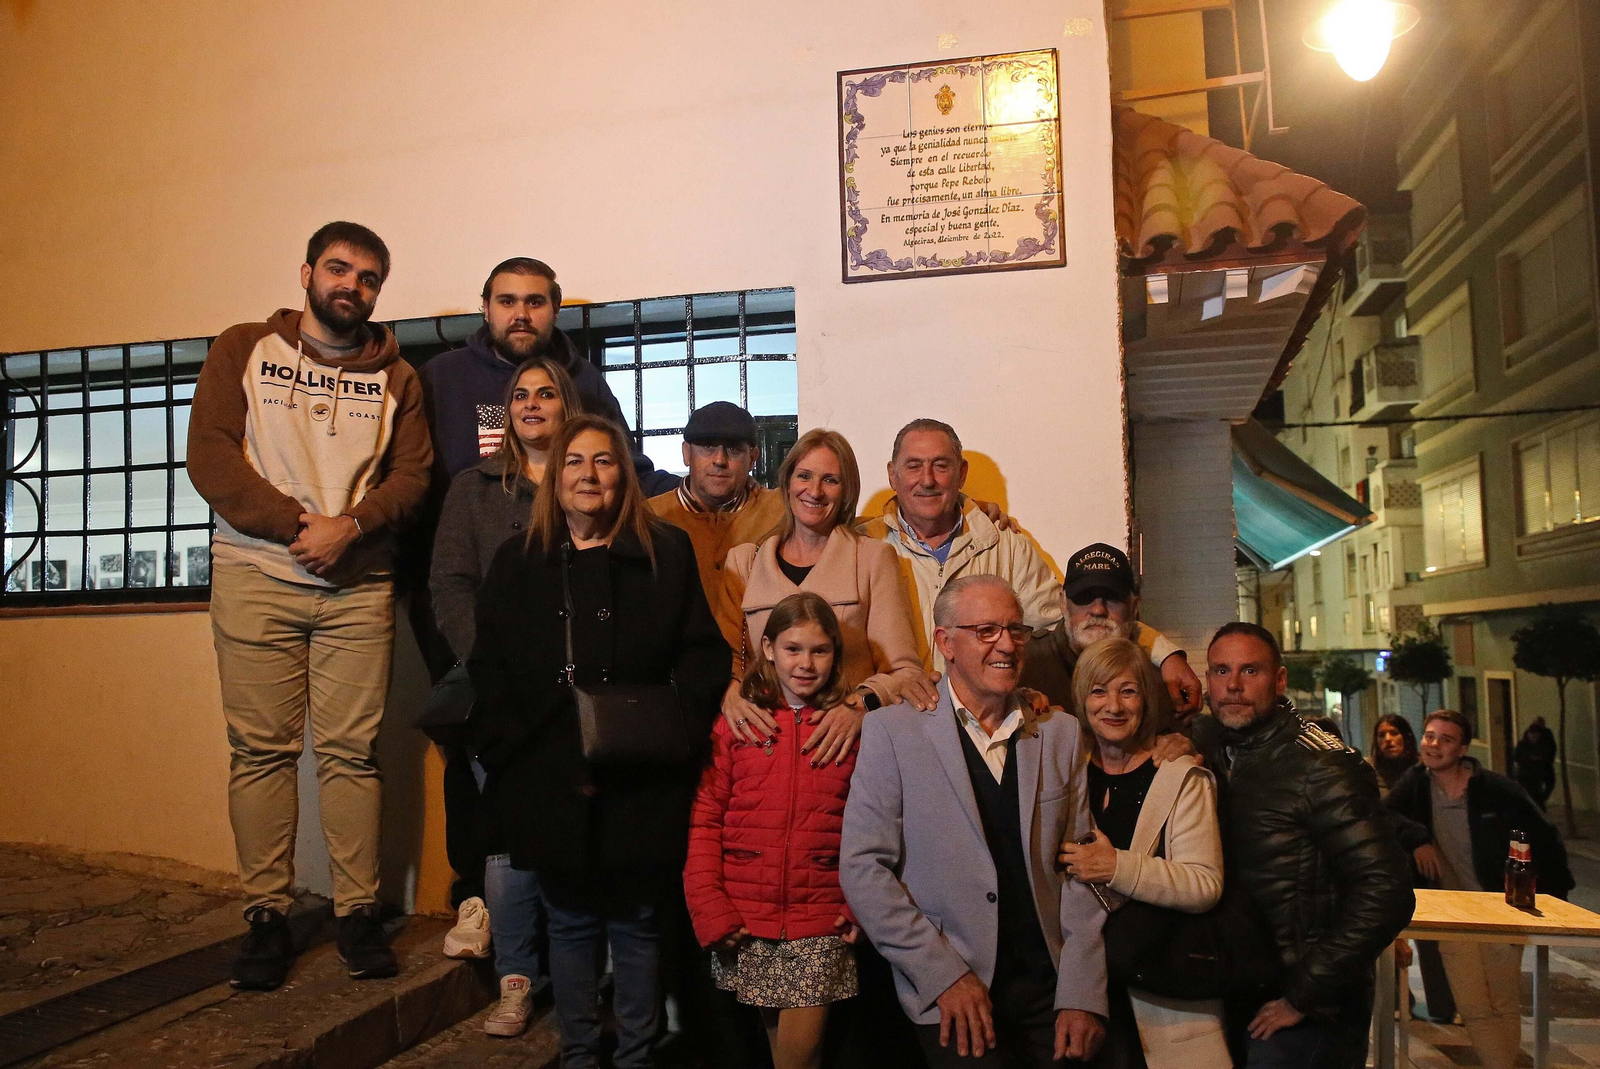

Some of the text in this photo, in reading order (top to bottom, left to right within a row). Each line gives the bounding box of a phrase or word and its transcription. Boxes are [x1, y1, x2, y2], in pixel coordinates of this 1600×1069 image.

[919, 126, 944, 140] genios
[946, 126, 960, 134] son
[880, 146, 891, 158] ya
[894, 144, 907, 156] que
[909, 140, 916, 150] la
[918, 137, 960, 154] genialidad
[964, 136, 988, 146] nunca
[890, 157, 922, 167] Siempre
[941, 152, 948, 162] el
[953, 148, 992, 160] recuerdo
[907, 161, 995, 178] de esta calle Libertad,
[910, 175, 992, 193] porque Pepe Rebolo
[887, 196, 900, 206] fue
[902, 191, 960, 207] precisamente,
[976, 188, 998, 198] alma
[1000, 186, 1022, 196] libre.
[881, 202, 1024, 223] En memoria de José González Díaz.
[905, 218, 1000, 236] especial y buena gente.
[903, 238, 936, 248] Algeciras,
[261, 361, 382, 395] HOLLISTER
[263, 398, 380, 421] PACIC COAST
[1075, 551, 1120, 568] ALGECIRAS
